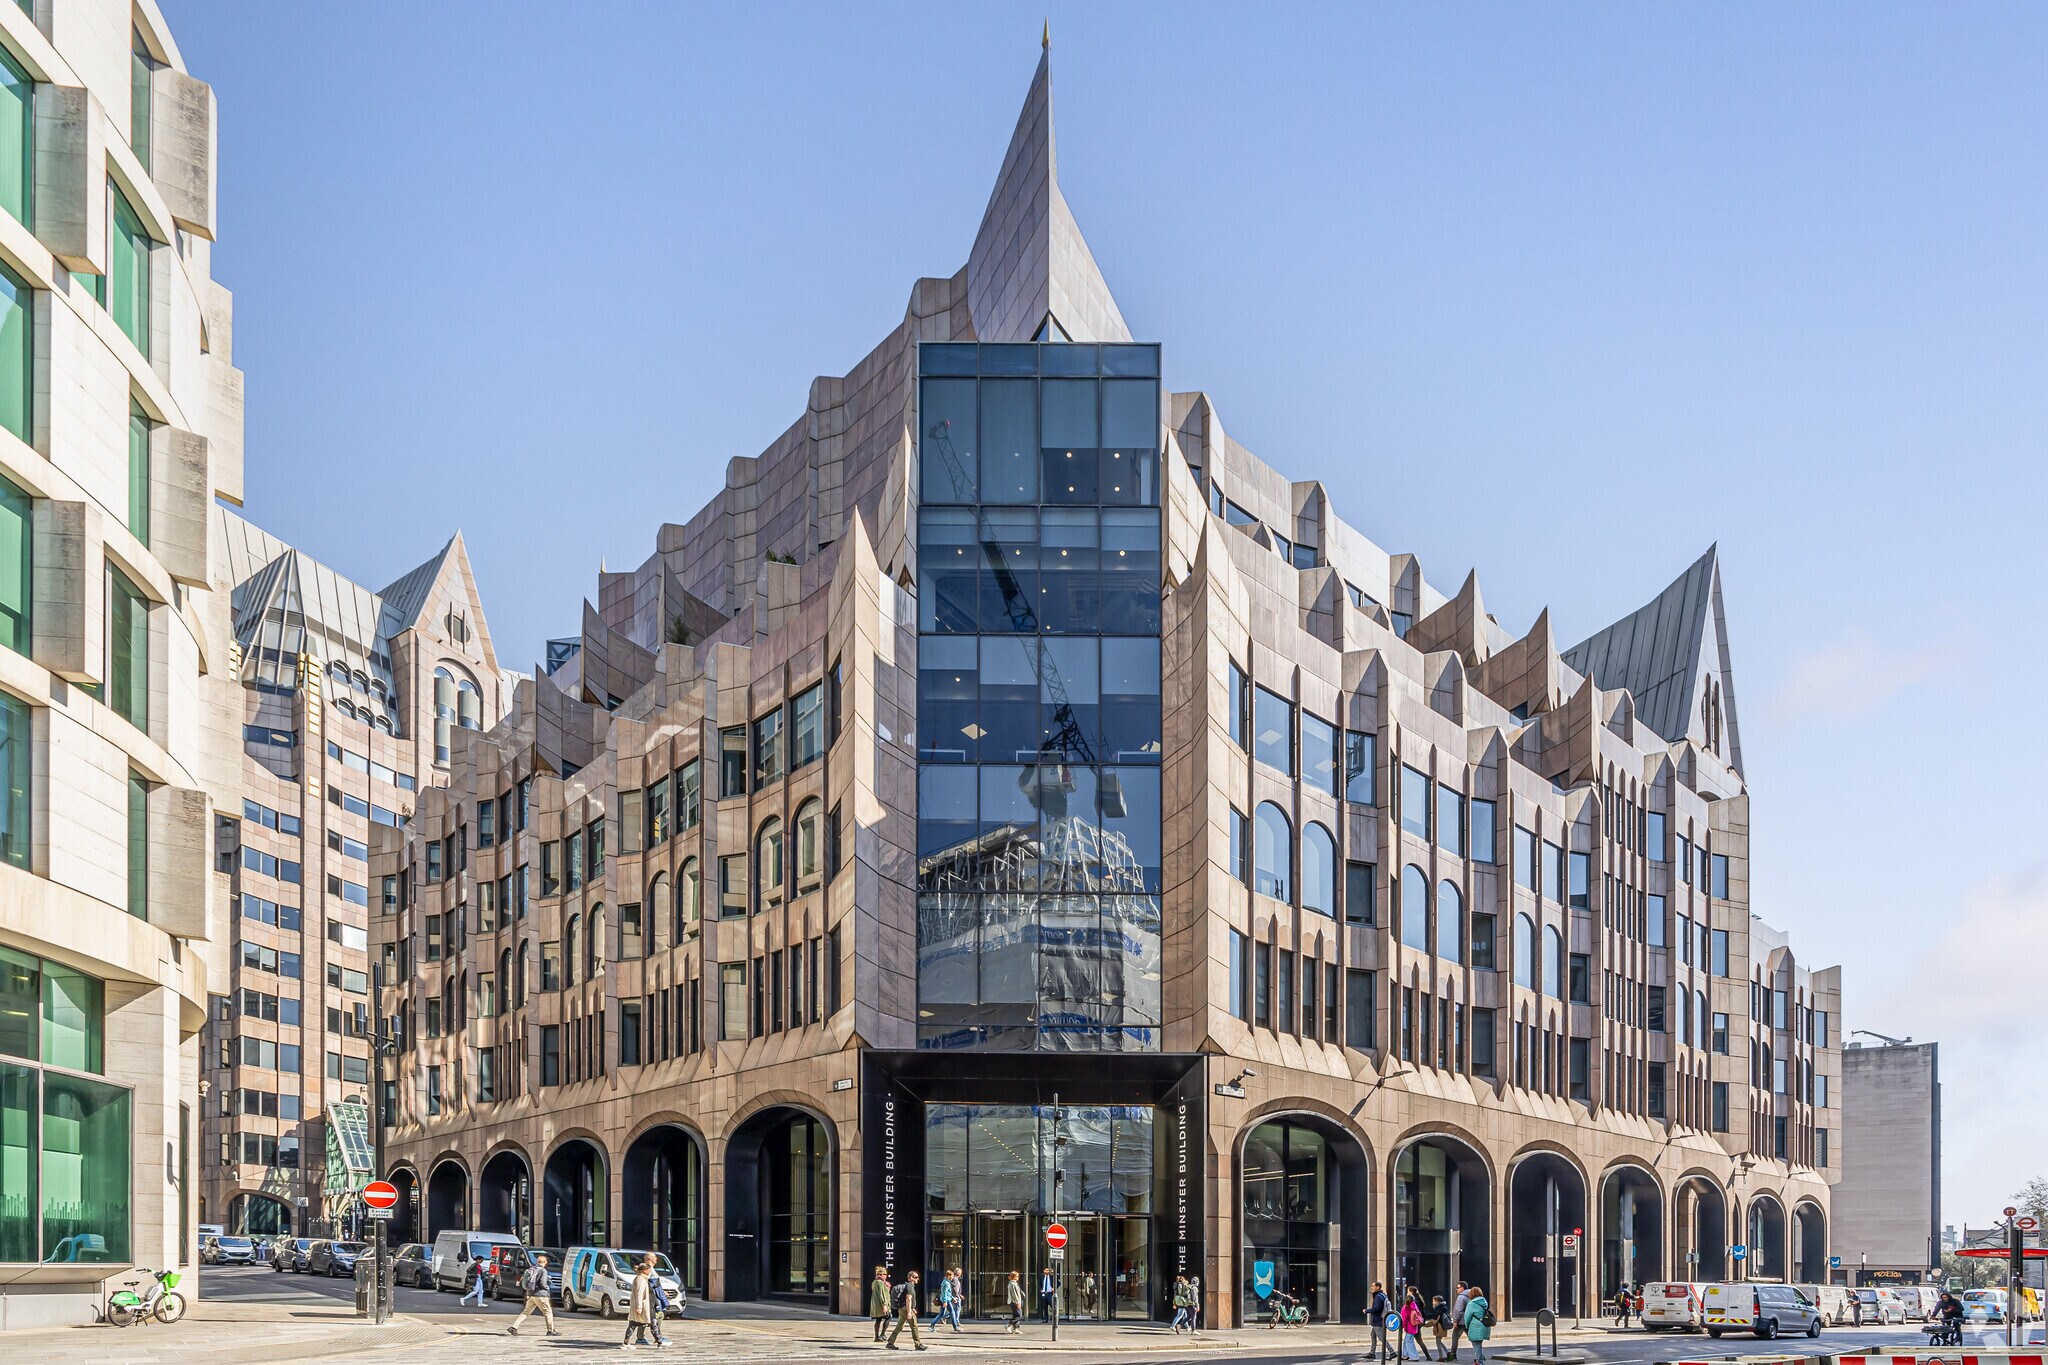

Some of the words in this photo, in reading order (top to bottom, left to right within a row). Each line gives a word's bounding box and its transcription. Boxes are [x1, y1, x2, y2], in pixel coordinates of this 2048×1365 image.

[885, 1101, 894, 1169] BUILDING
[1178, 1104, 1187, 1172] BUILDING
[885, 1175, 894, 1236] MINSTER
[1178, 1178, 1187, 1239] MINSTER
[885, 1242, 894, 1269] THE
[1178, 1245, 1187, 1273] THE
